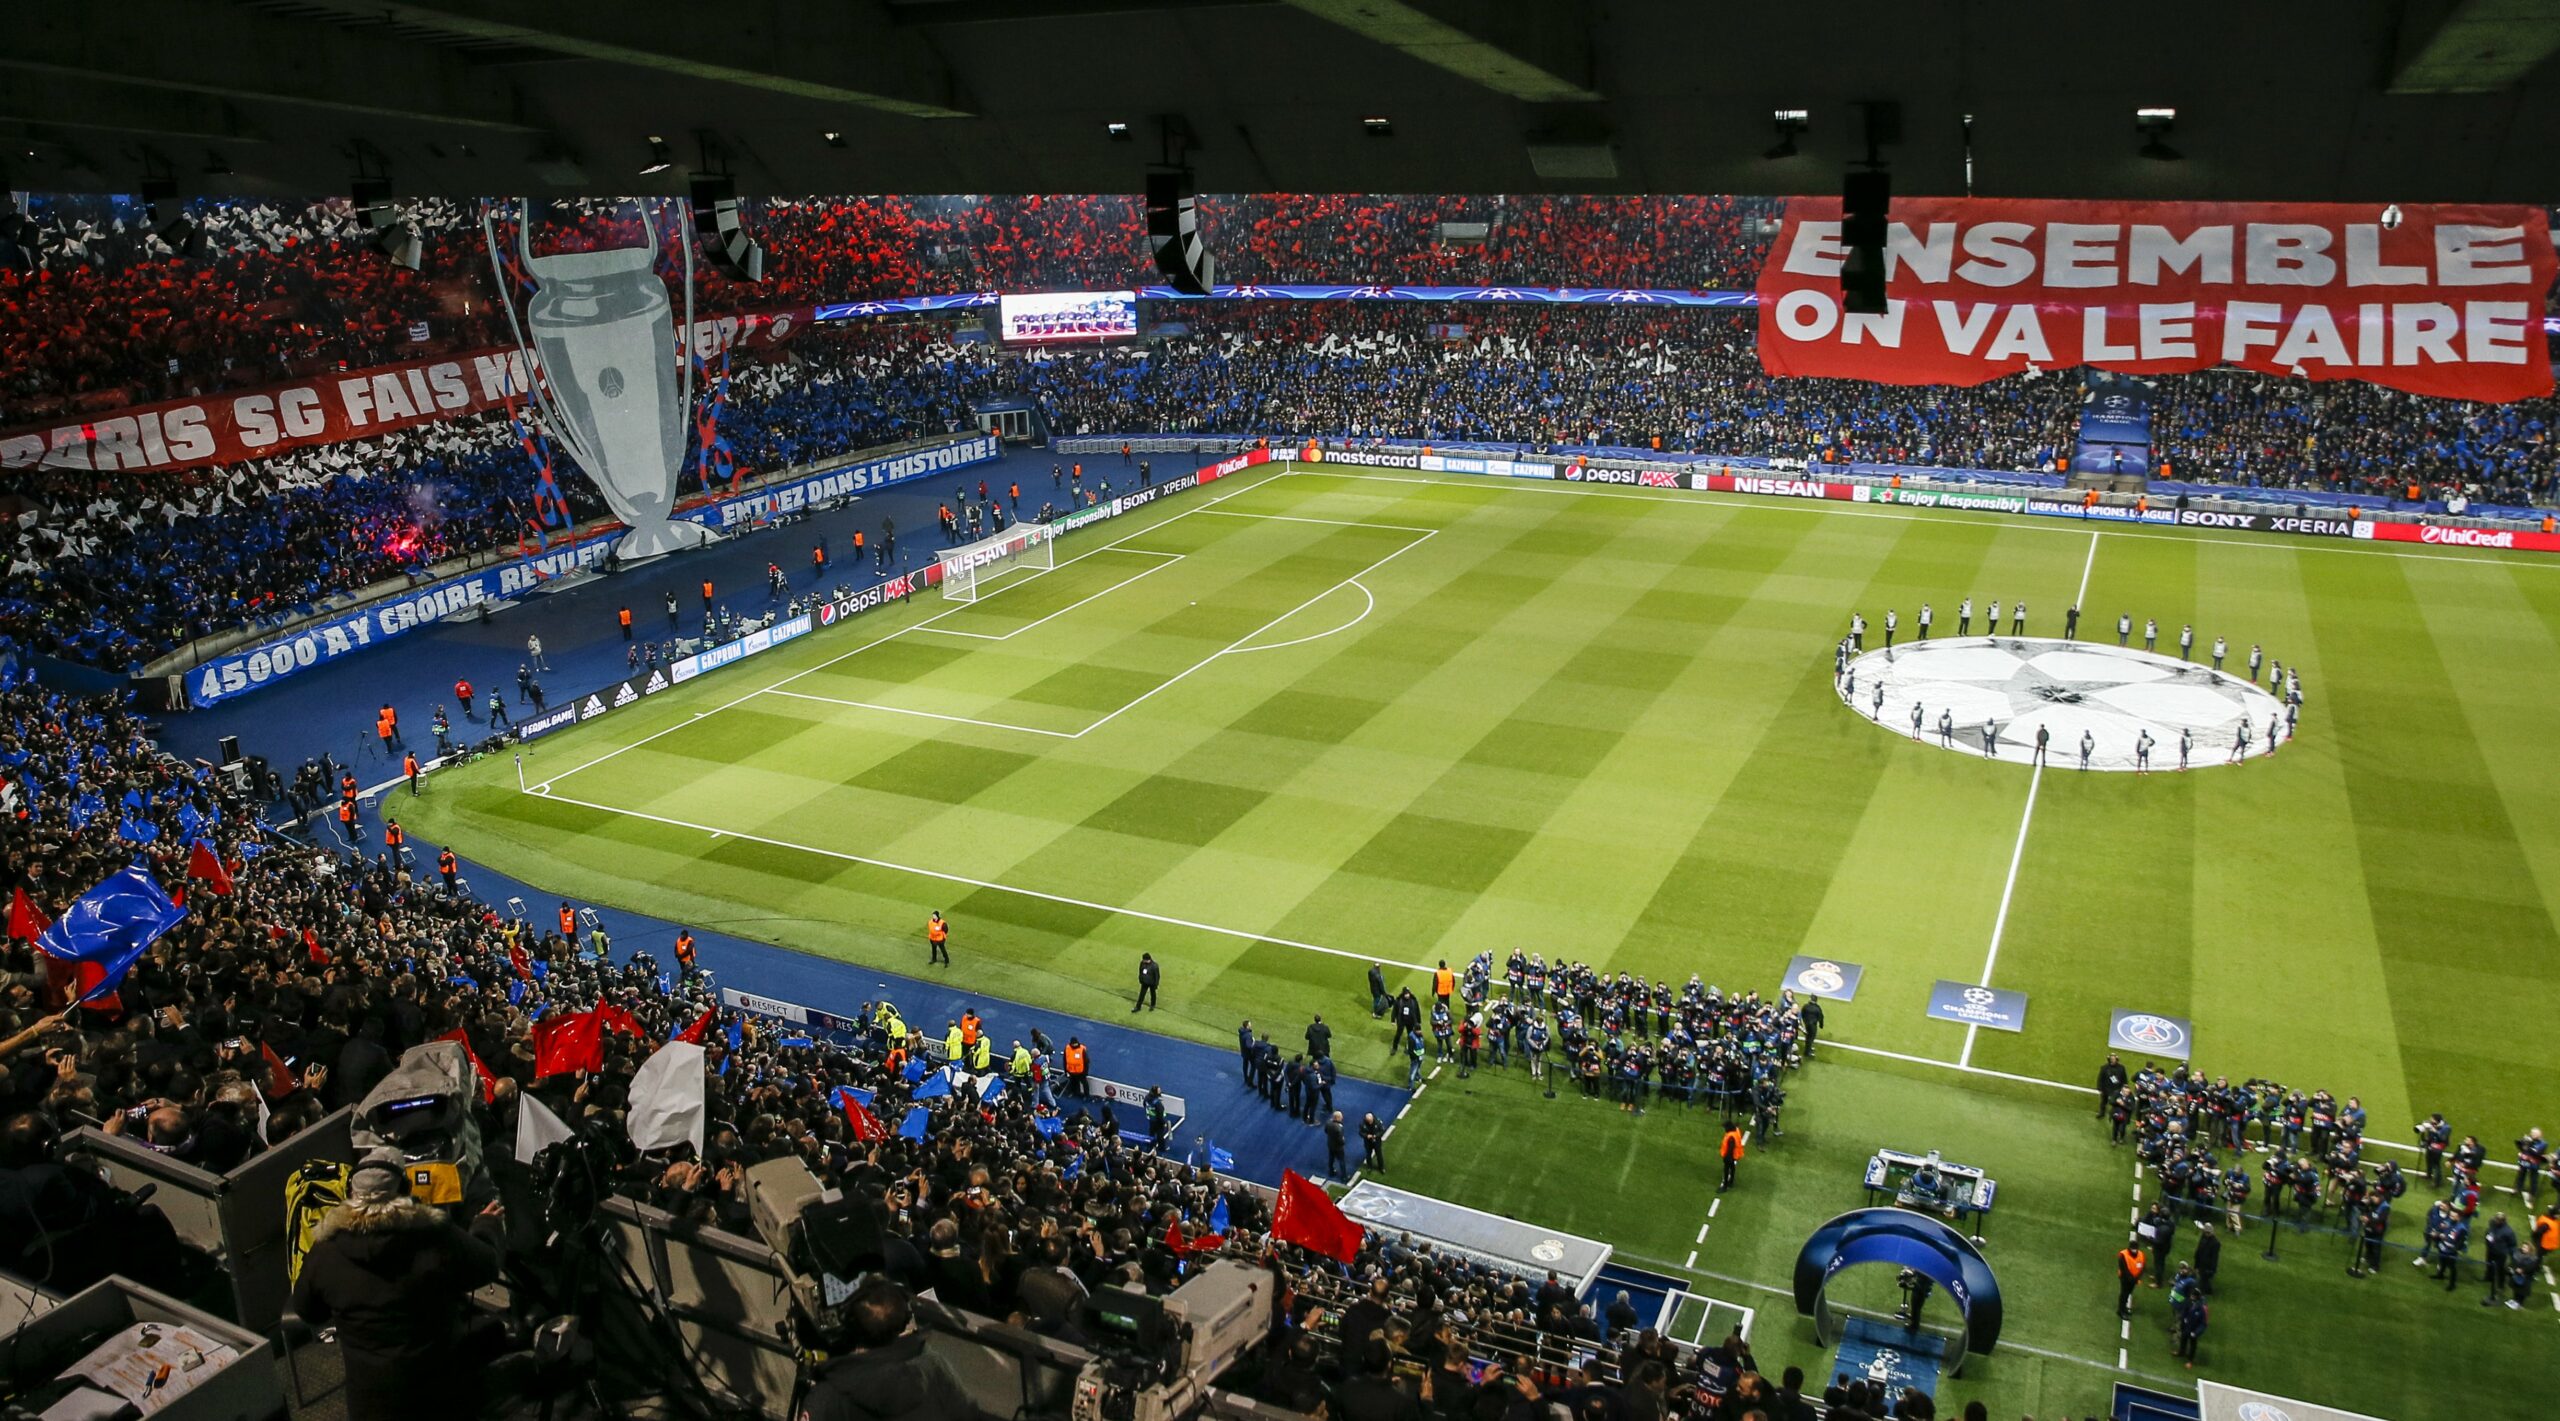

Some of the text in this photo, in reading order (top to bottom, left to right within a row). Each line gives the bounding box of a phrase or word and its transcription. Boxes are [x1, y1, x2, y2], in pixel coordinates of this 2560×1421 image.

[1782, 221, 2532, 288] ENSEMBLE
[1775, 289, 2529, 366] ON VA LE FAIRE
[0, 404, 217, 472] PARIS
[338, 361, 470, 426] FAIS
[1222, 455, 1249, 474] UniCredit
[1325, 450, 1417, 468] mastercard
[1513, 463, 1553, 476] GAZPROM
[1586, 468, 1680, 488] pepsi MAX
[1734, 477, 1825, 498] NISSAN
[1122, 475, 1197, 510] SONY XPERIA
[1898, 491, 2024, 513] Enjoy Responsibly
[1066, 504, 1113, 530] Responsibly
[2029, 502, 2060, 513] UEFA
[2128, 508, 2173, 521] LAGUE
[2181, 511, 2350, 536] SONY XPERIA
[2440, 528, 2514, 548] UniCredit
[946, 543, 1008, 577] NISSAN
[200, 637, 318, 699] 45000
[806, 467, 868, 505] DANS
[840, 572, 917, 620] pepsi MAX
[771, 616, 810, 642] GAZPROM
[701, 643, 742, 669] GAZPROM
[645, 680, 669, 695] adidas
[614, 692, 639, 707] adidas
[581, 705, 607, 720] adidas
[751, 999, 788, 1016] RESPECT
[1942, 1004, 2009, 1021] CHAMPIONS
